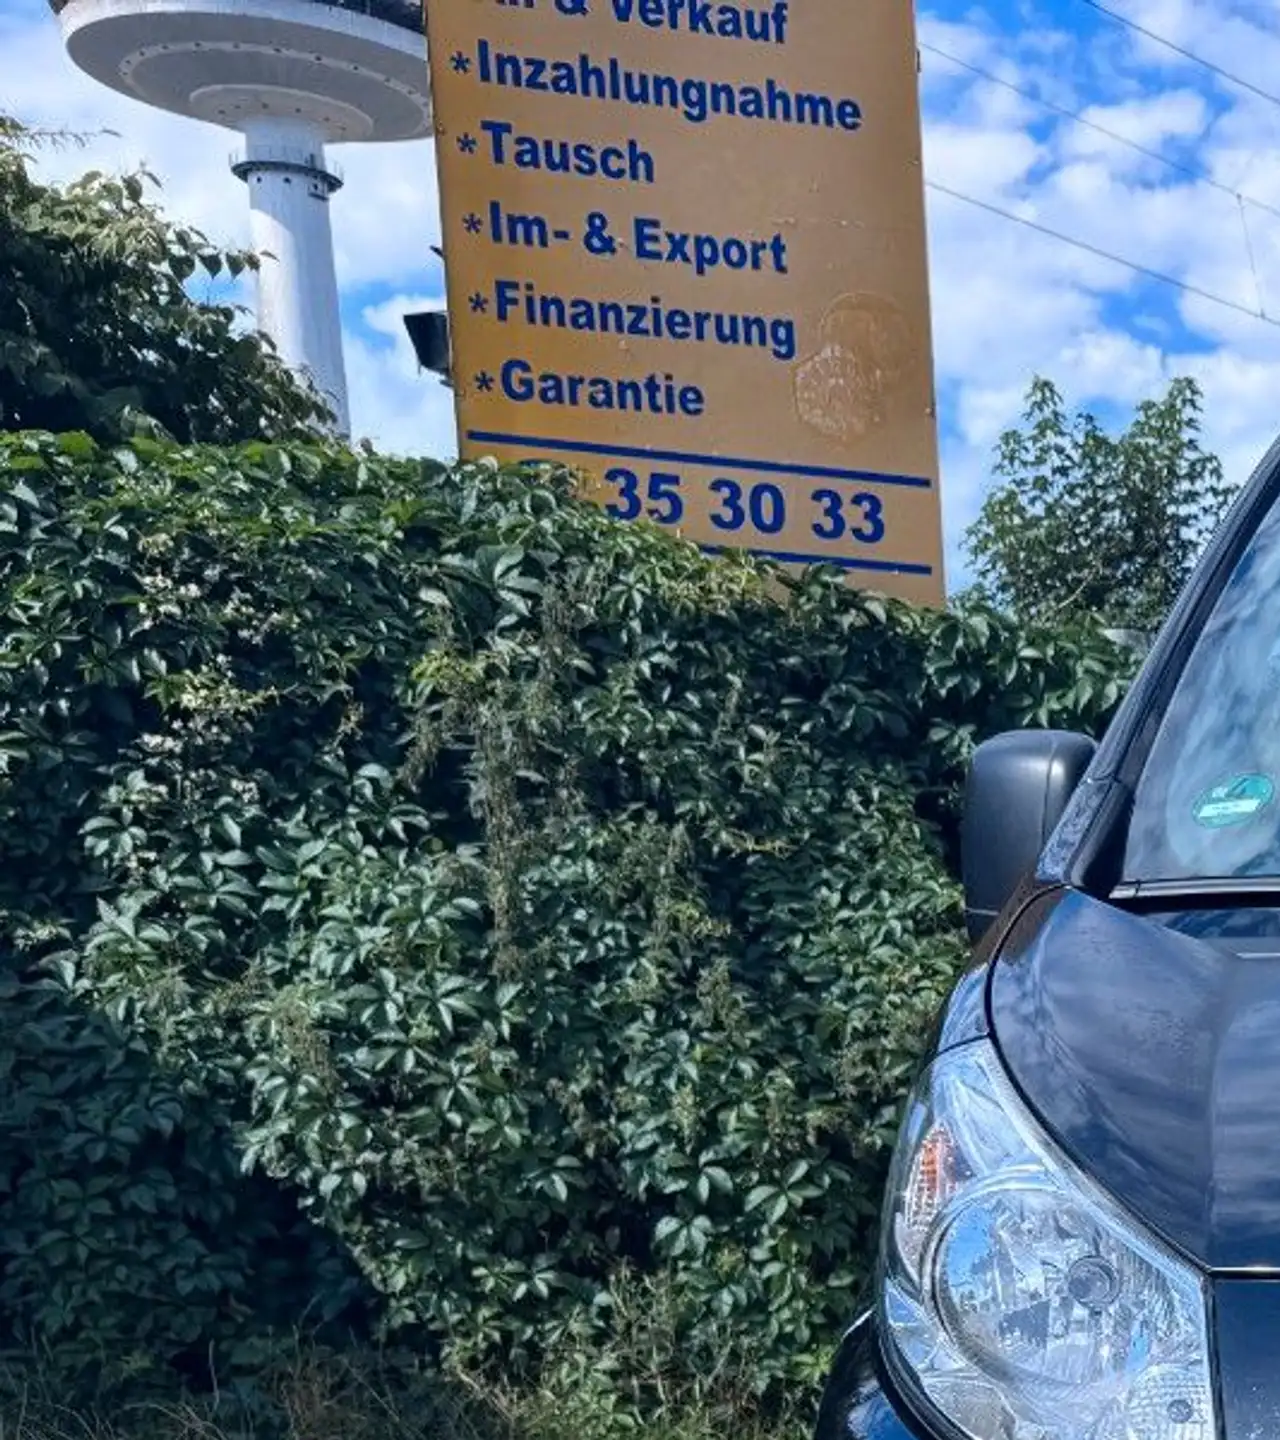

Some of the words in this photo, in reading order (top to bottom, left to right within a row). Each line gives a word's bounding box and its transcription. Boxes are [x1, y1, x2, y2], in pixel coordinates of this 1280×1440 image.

[477, 39, 862, 131] Inzahlungnahme
[481, 121, 655, 183] Tausch
[489, 200, 569, 248] Im-
[583, 211, 617, 256] &
[634, 217, 789, 276] Export
[494, 279, 797, 360] Finanzierung
[500, 359, 705, 416] Garantie
[604, 467, 683, 525] 35
[709, 477, 786, 535] 30
[810, 488, 885, 543] 33
